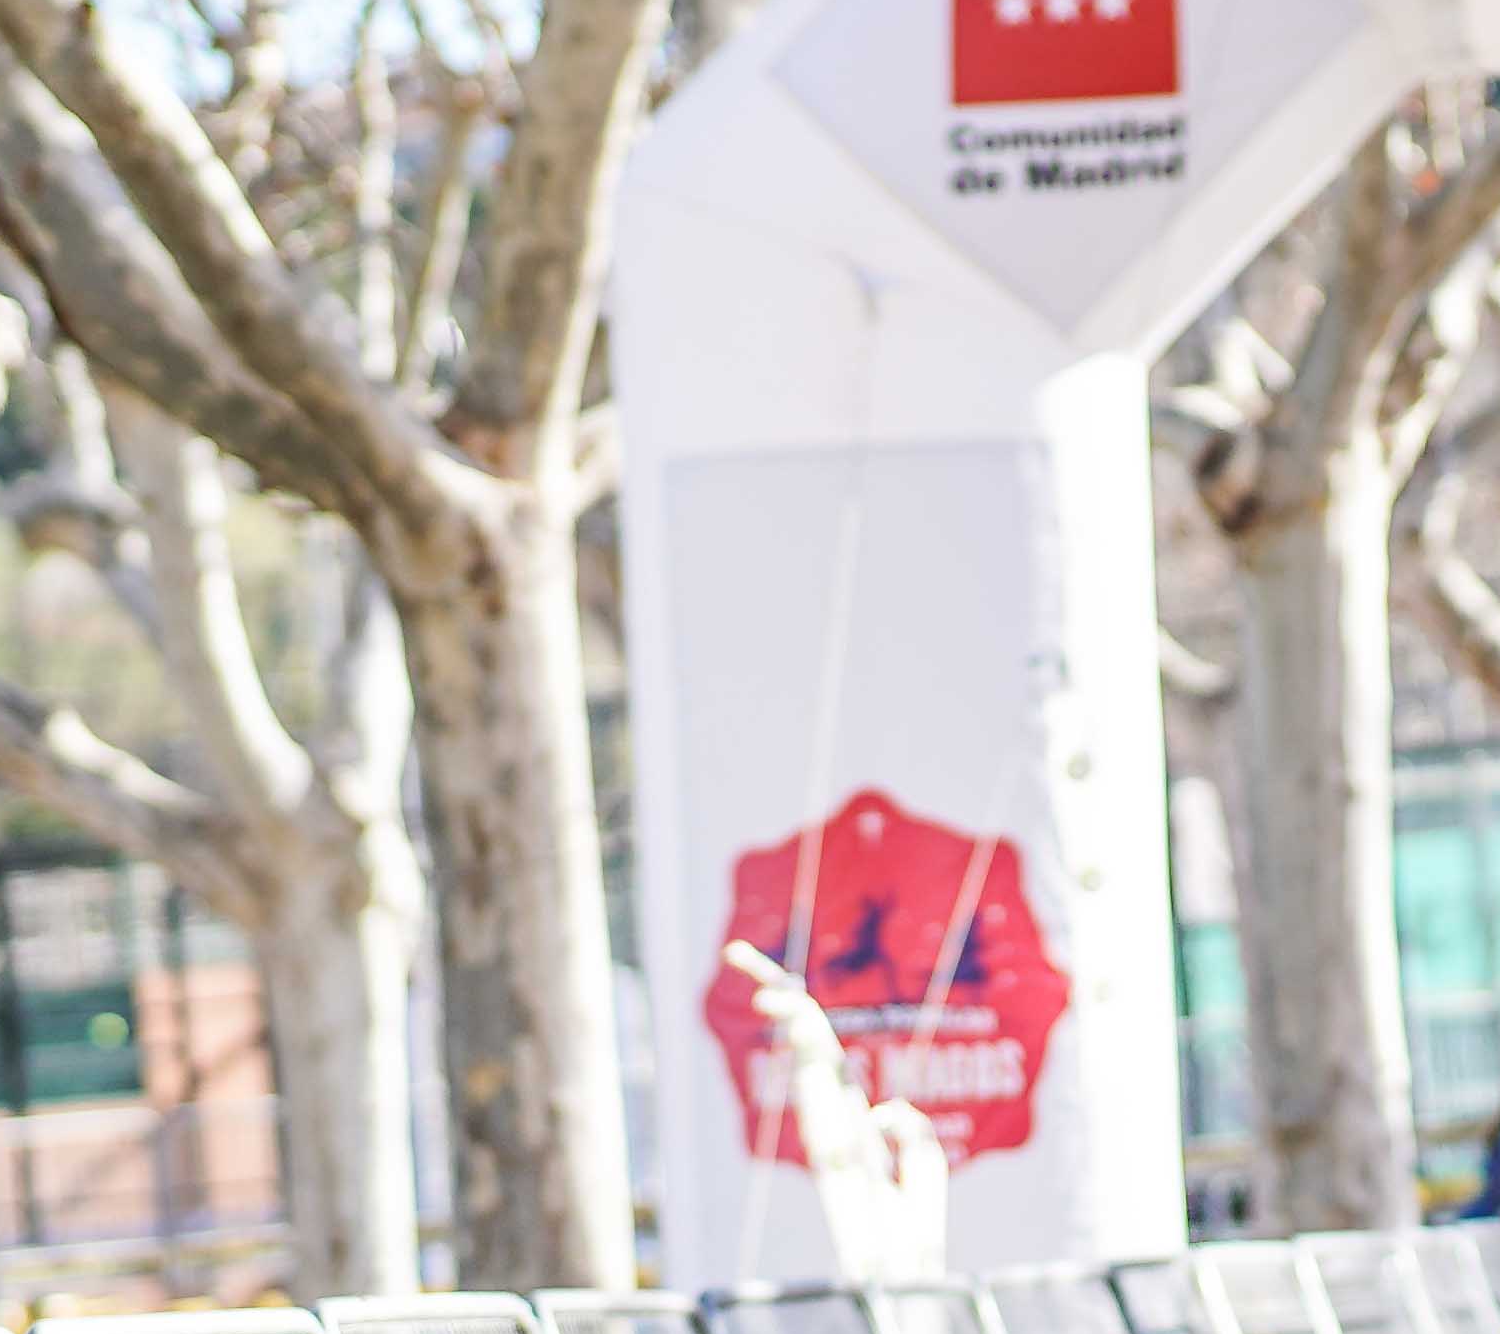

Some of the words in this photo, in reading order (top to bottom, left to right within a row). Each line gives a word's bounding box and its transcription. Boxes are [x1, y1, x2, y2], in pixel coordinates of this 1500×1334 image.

[948, 116, 1186, 153] Comunidad
[950, 165, 1003, 195] de
[1024, 155, 1186, 189] Madrid
